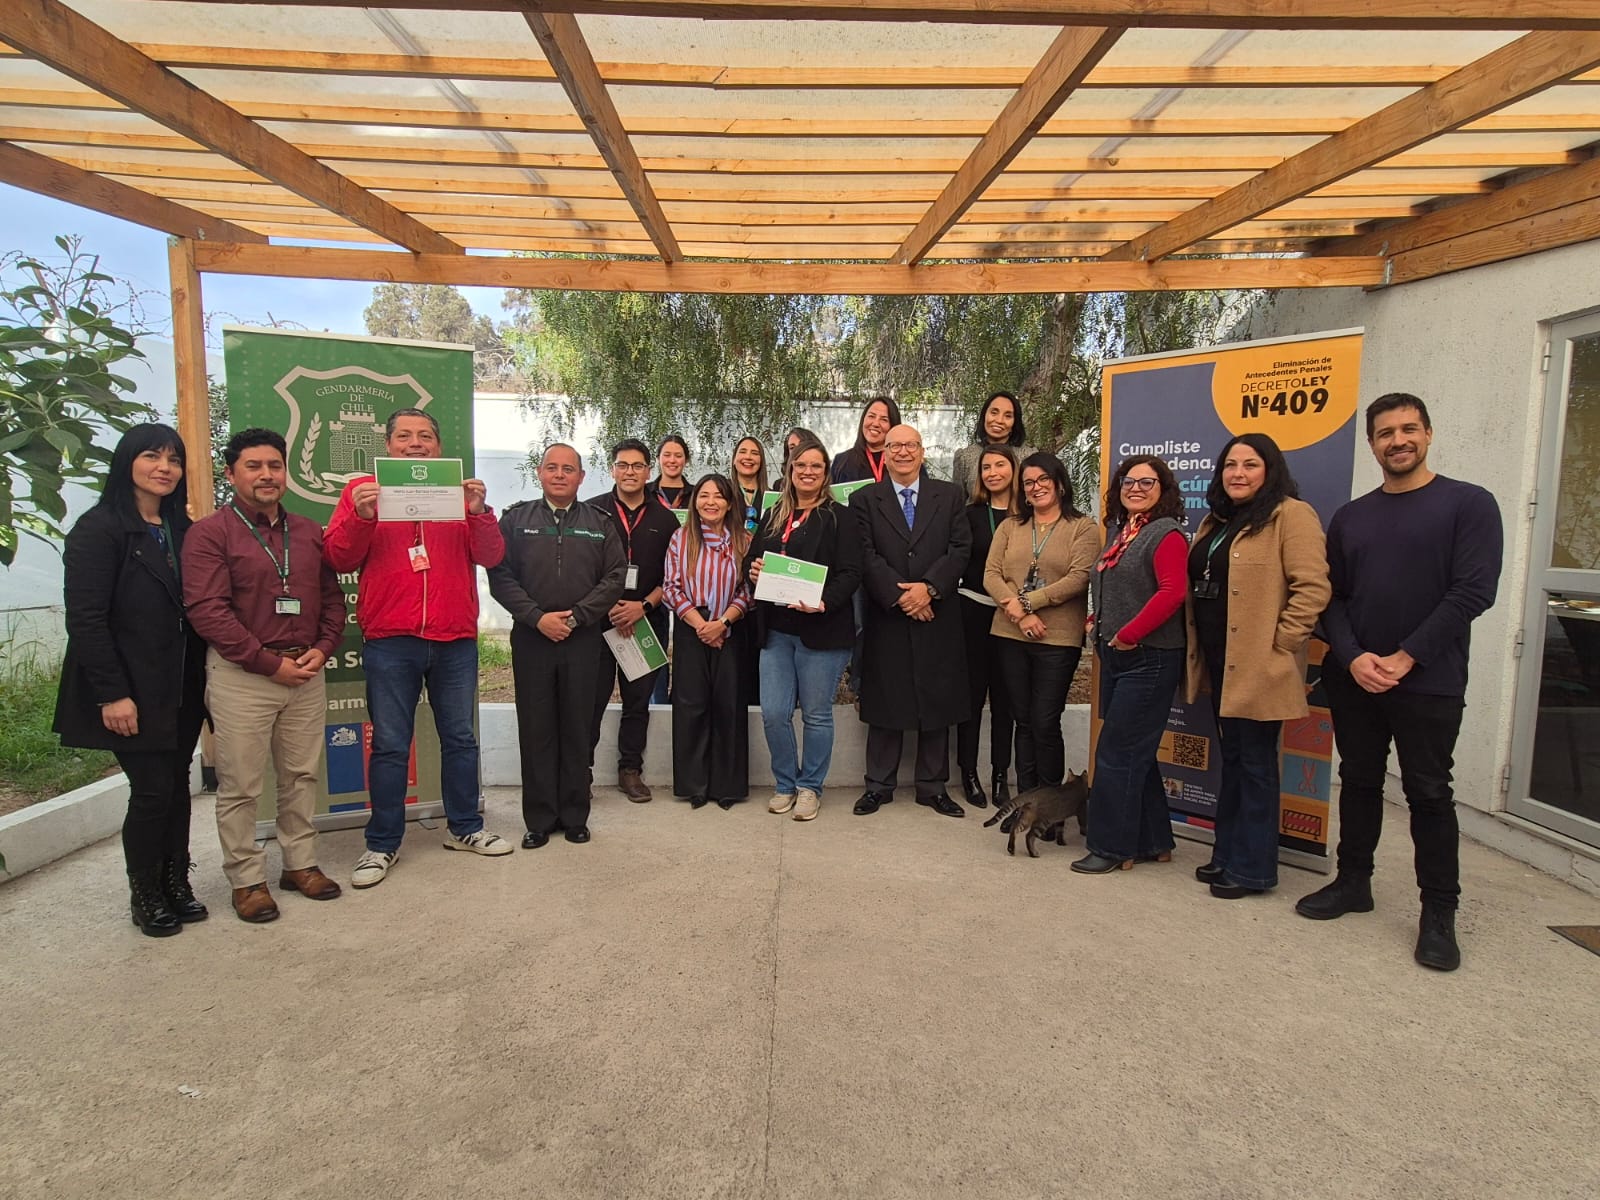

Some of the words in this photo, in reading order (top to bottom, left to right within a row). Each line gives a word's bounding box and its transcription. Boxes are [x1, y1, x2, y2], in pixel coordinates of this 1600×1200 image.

[1273, 358, 1319, 369] Eliminación
[1245, 369, 1298, 379] Antecedentes
[1300, 364, 1333, 374] Penales
[316, 384, 395, 403] GENDARMERIA
[350, 393, 365, 402] DE
[341, 402, 375, 413] CHILE
[1119, 440, 1201, 457] Cumpliste
